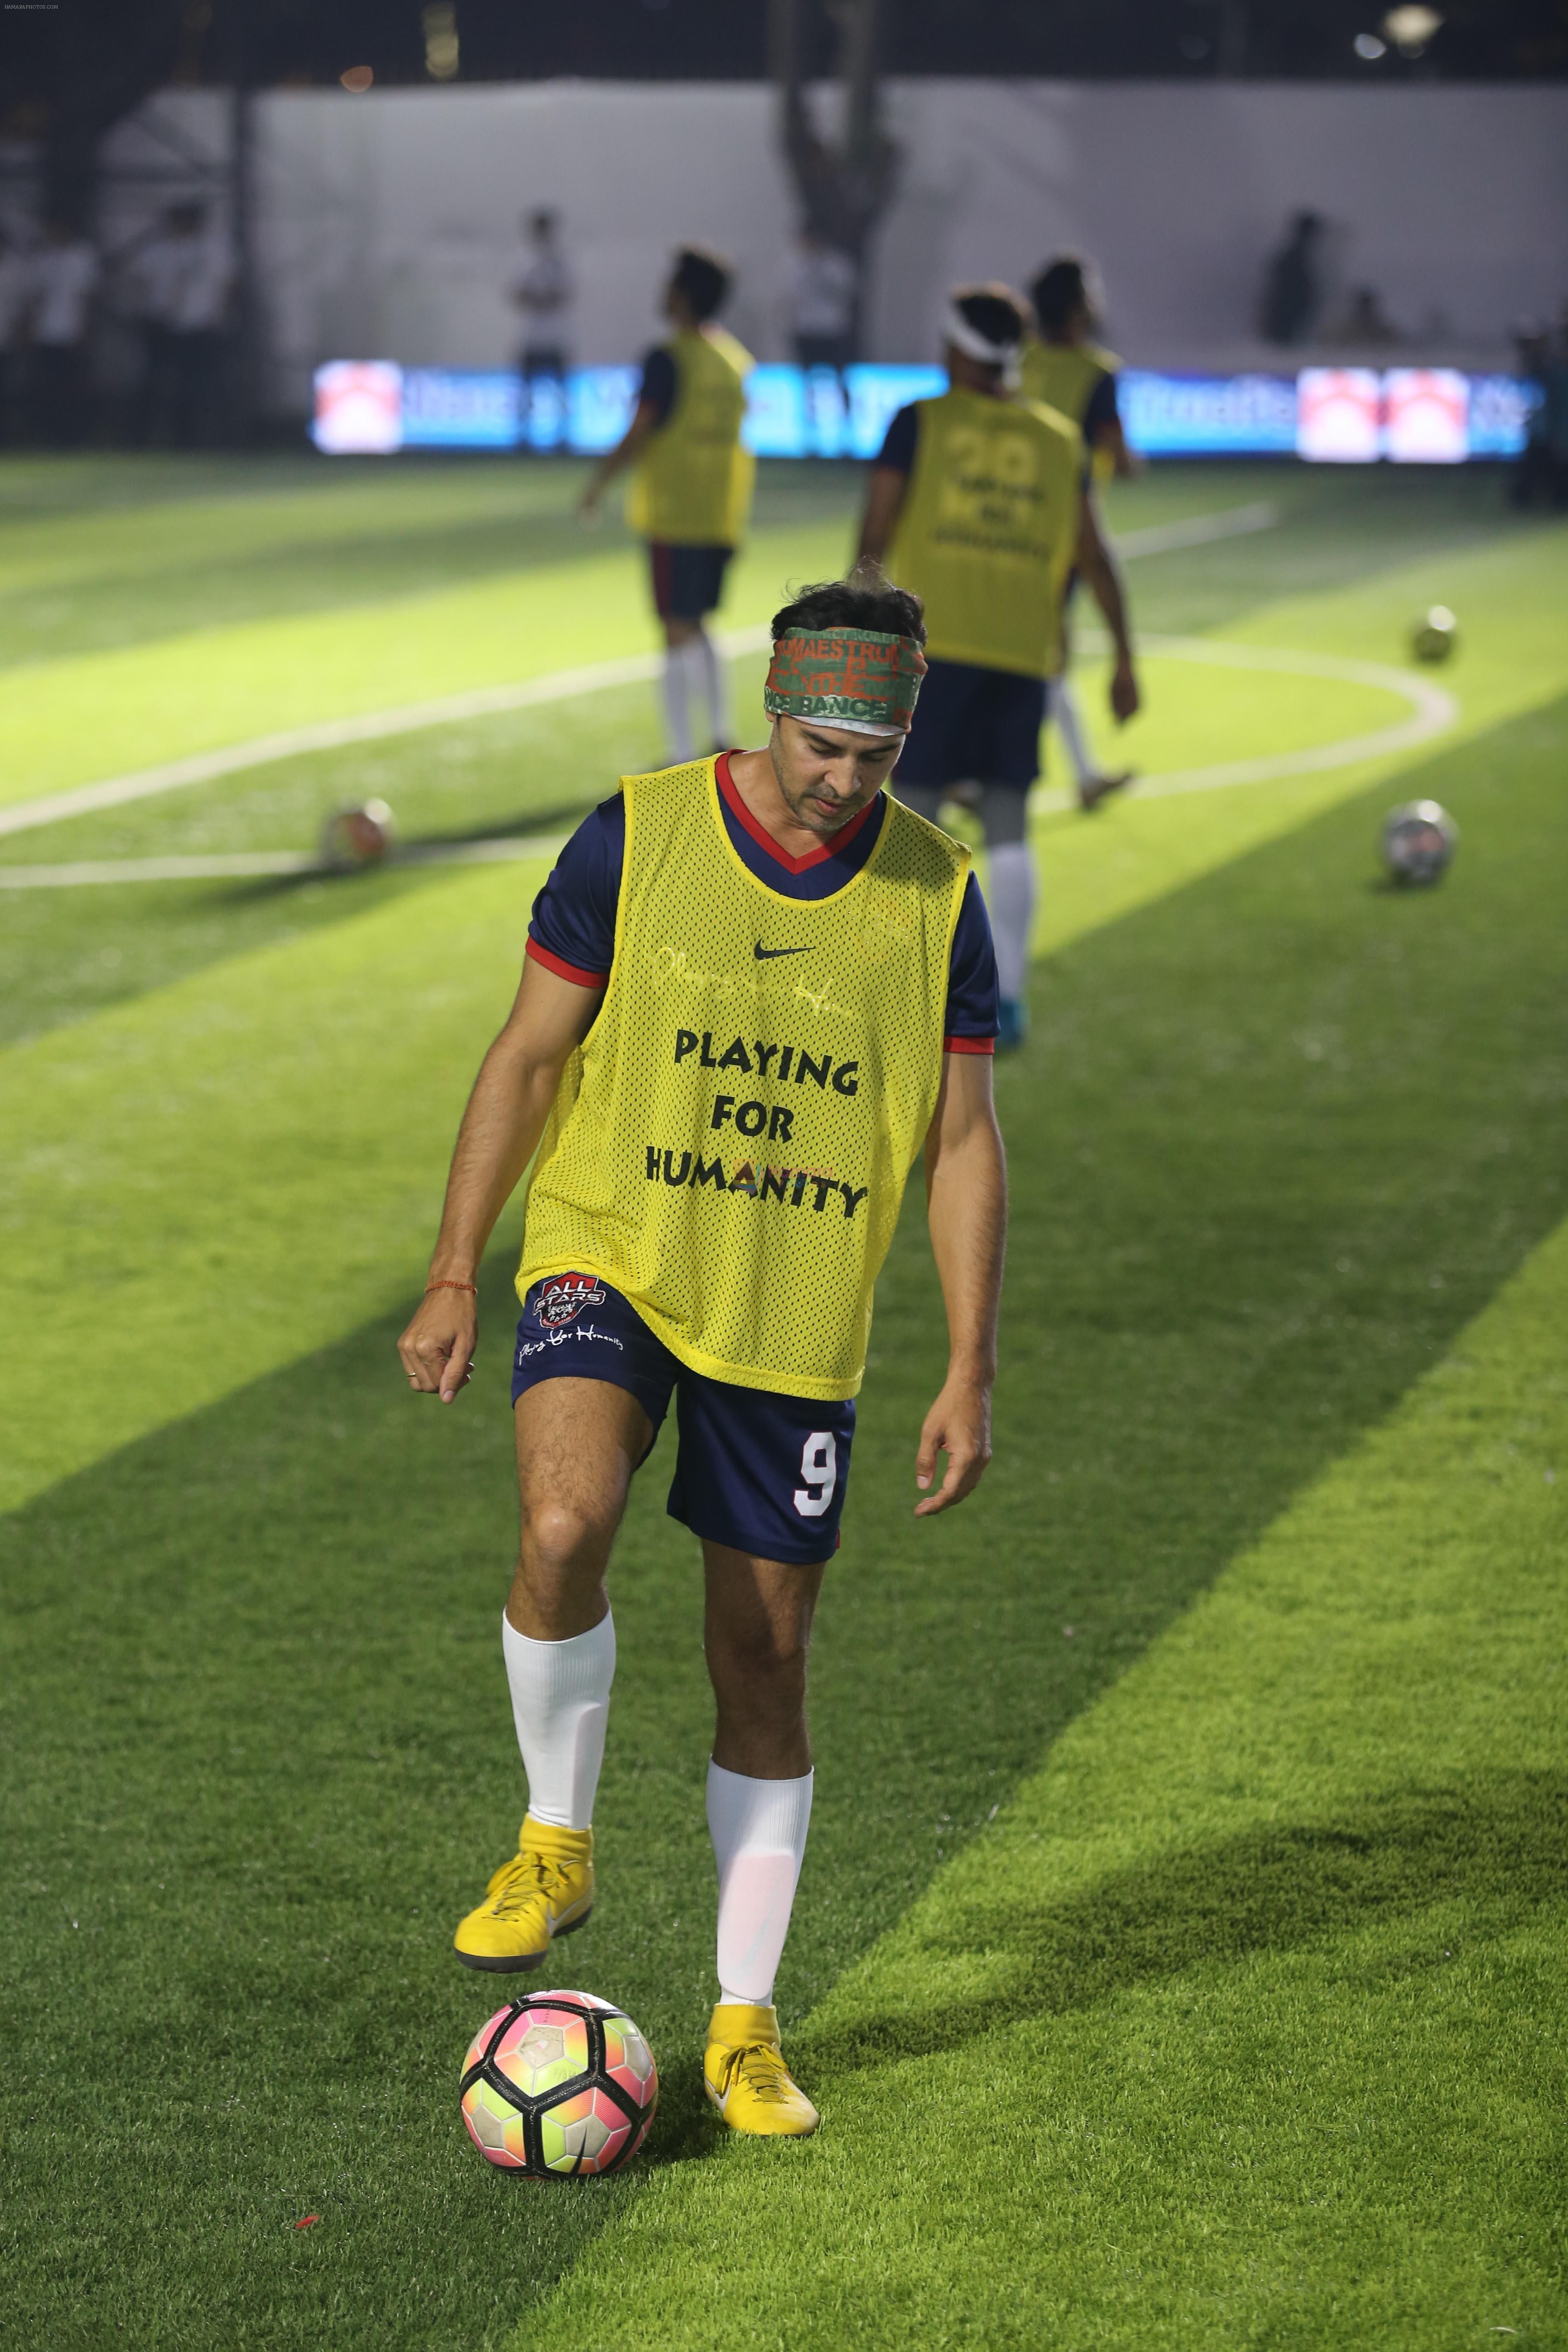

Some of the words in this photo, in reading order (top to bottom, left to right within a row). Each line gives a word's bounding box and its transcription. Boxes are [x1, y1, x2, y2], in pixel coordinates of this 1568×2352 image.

[674, 1029, 859, 1096] PLAYING
[711, 1095, 794, 1143] FOR
[646, 1146, 867, 1218] HUMANITY
[534, 1293, 602, 1312] STARS
[545, 1281, 592, 1298] ALL
[793, 1431, 836, 1516] 9
